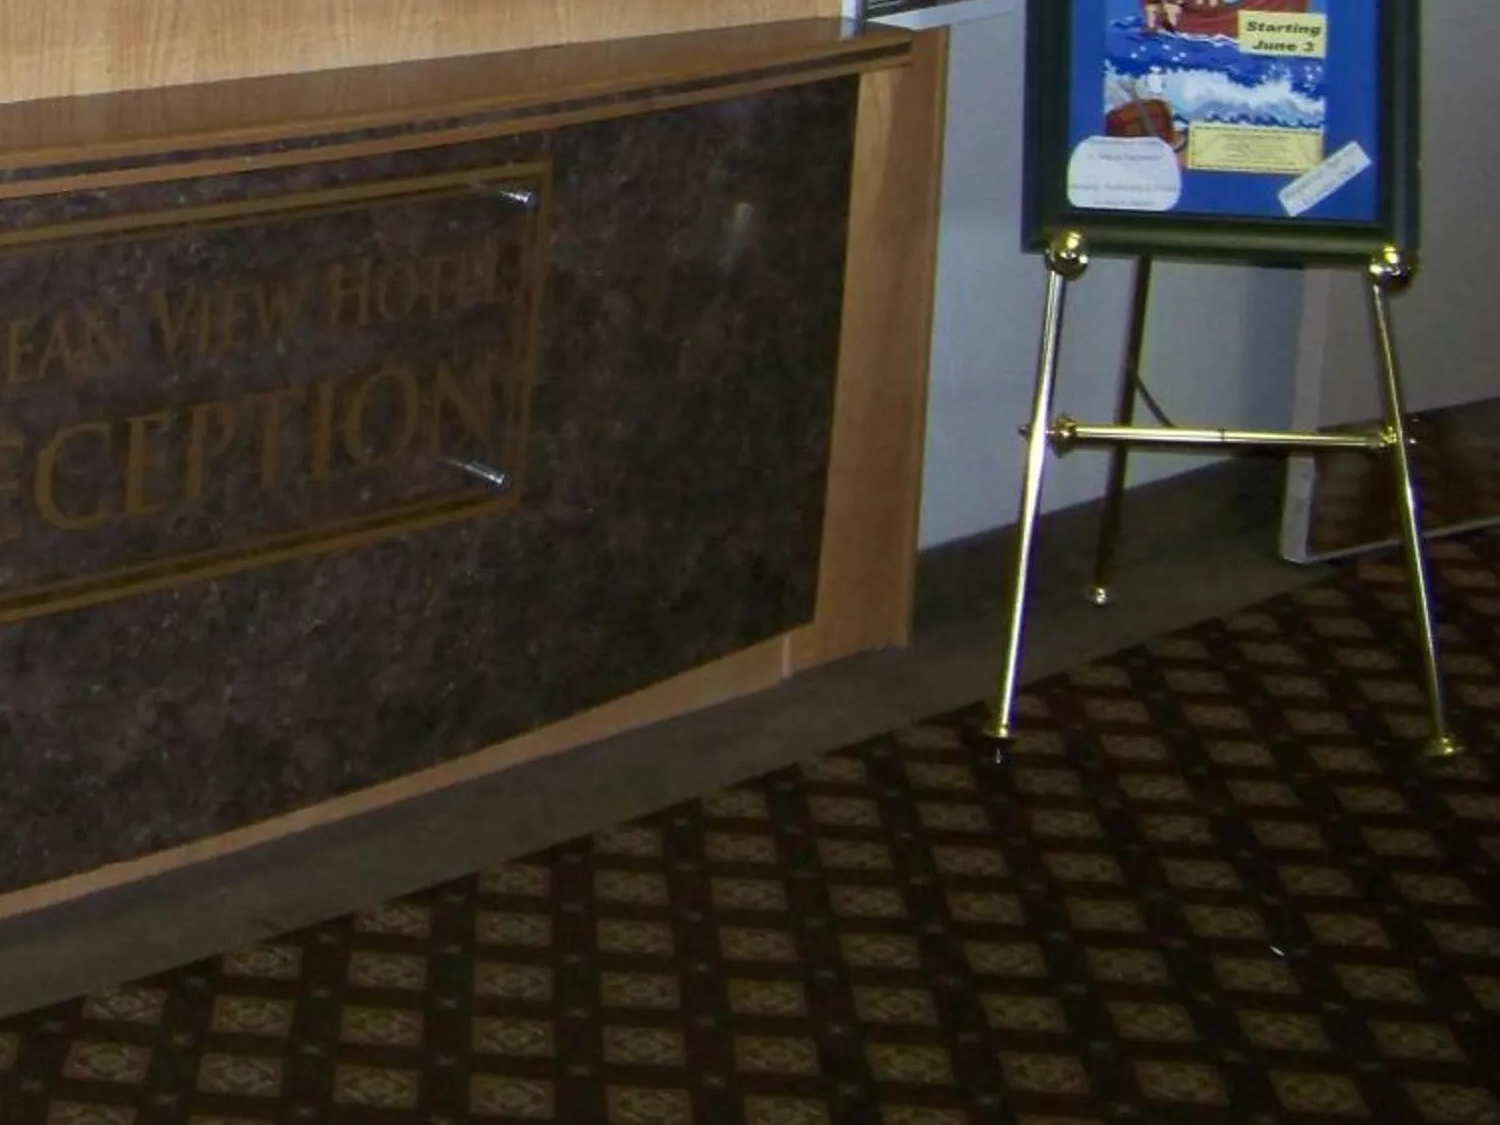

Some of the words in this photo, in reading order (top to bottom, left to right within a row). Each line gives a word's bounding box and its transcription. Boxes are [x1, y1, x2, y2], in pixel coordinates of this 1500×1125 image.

[1245, 19, 1322, 38] Starting
[1251, 39, 1299, 52] June
[1303, 40, 1316, 53] 3
[153, 275, 316, 359] VIEW
[328, 244, 506, 328] HOTEL
